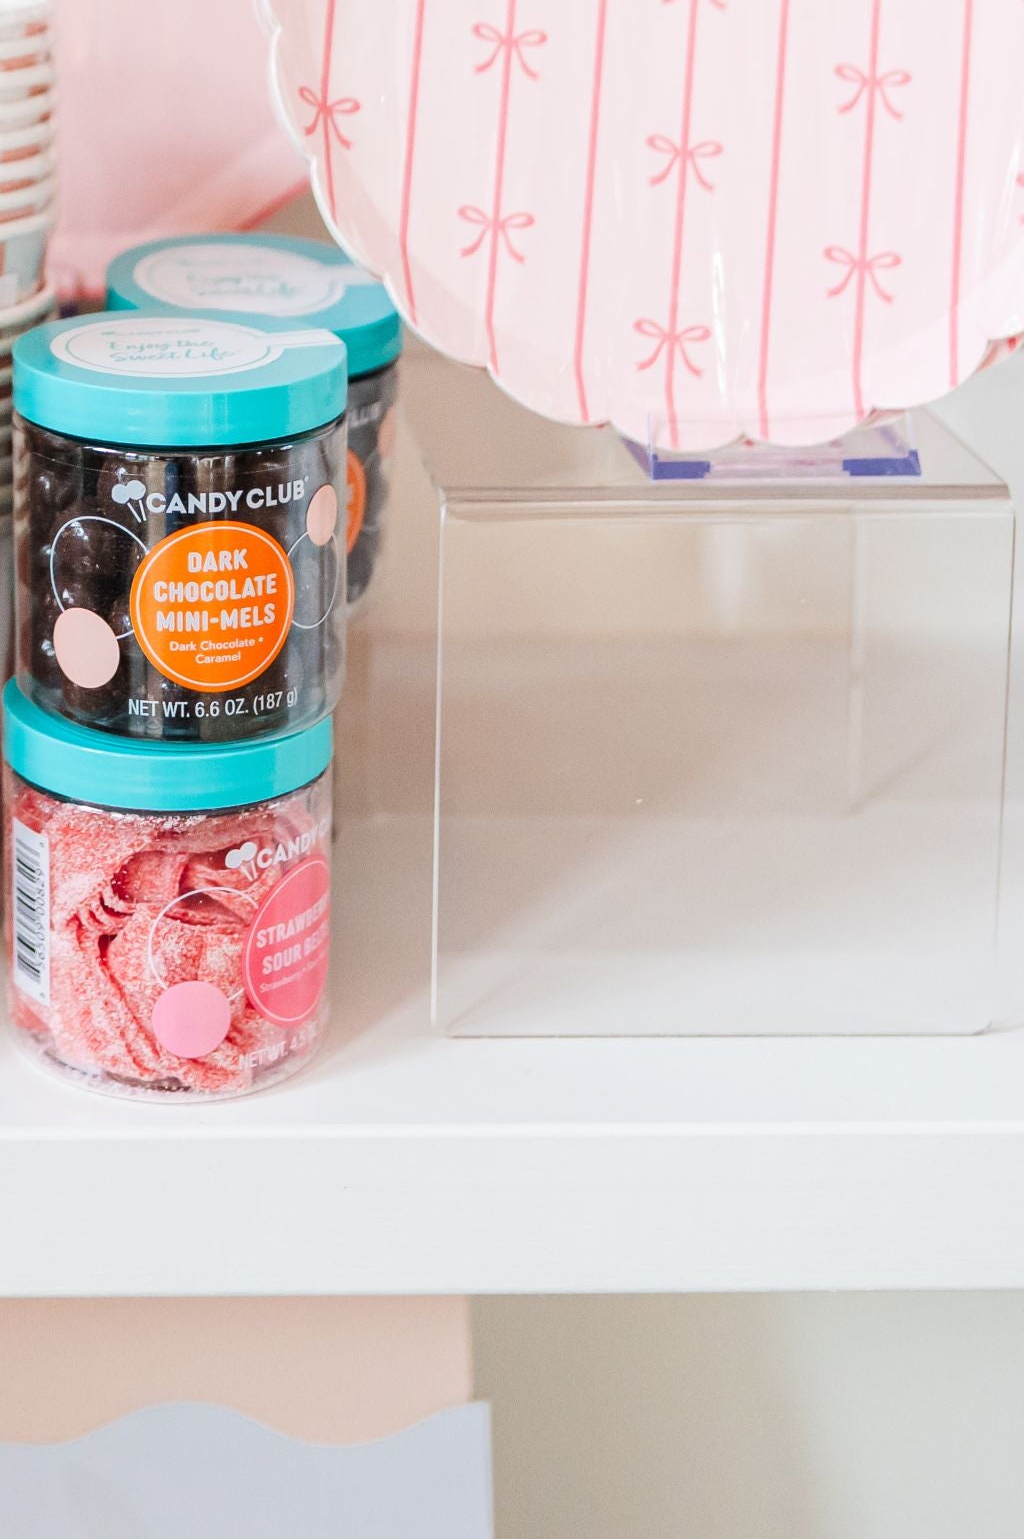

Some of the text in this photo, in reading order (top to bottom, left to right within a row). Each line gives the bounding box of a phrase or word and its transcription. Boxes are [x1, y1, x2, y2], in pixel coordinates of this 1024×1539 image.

[145, 479, 306, 514] CANDY CLUB
[187, 548, 249, 573] DARK
[153, 572, 278, 603] CHOCOLATE
[156, 603, 276, 633] MINI-MELS
[169, 637, 256, 652] Dark Chocolate
[195, 651, 241, 665] Caramel
[128, 687, 298, 718] NET WT. 6.6 OZ. (187 g)
[262, 943, 302, 975] SOUR
